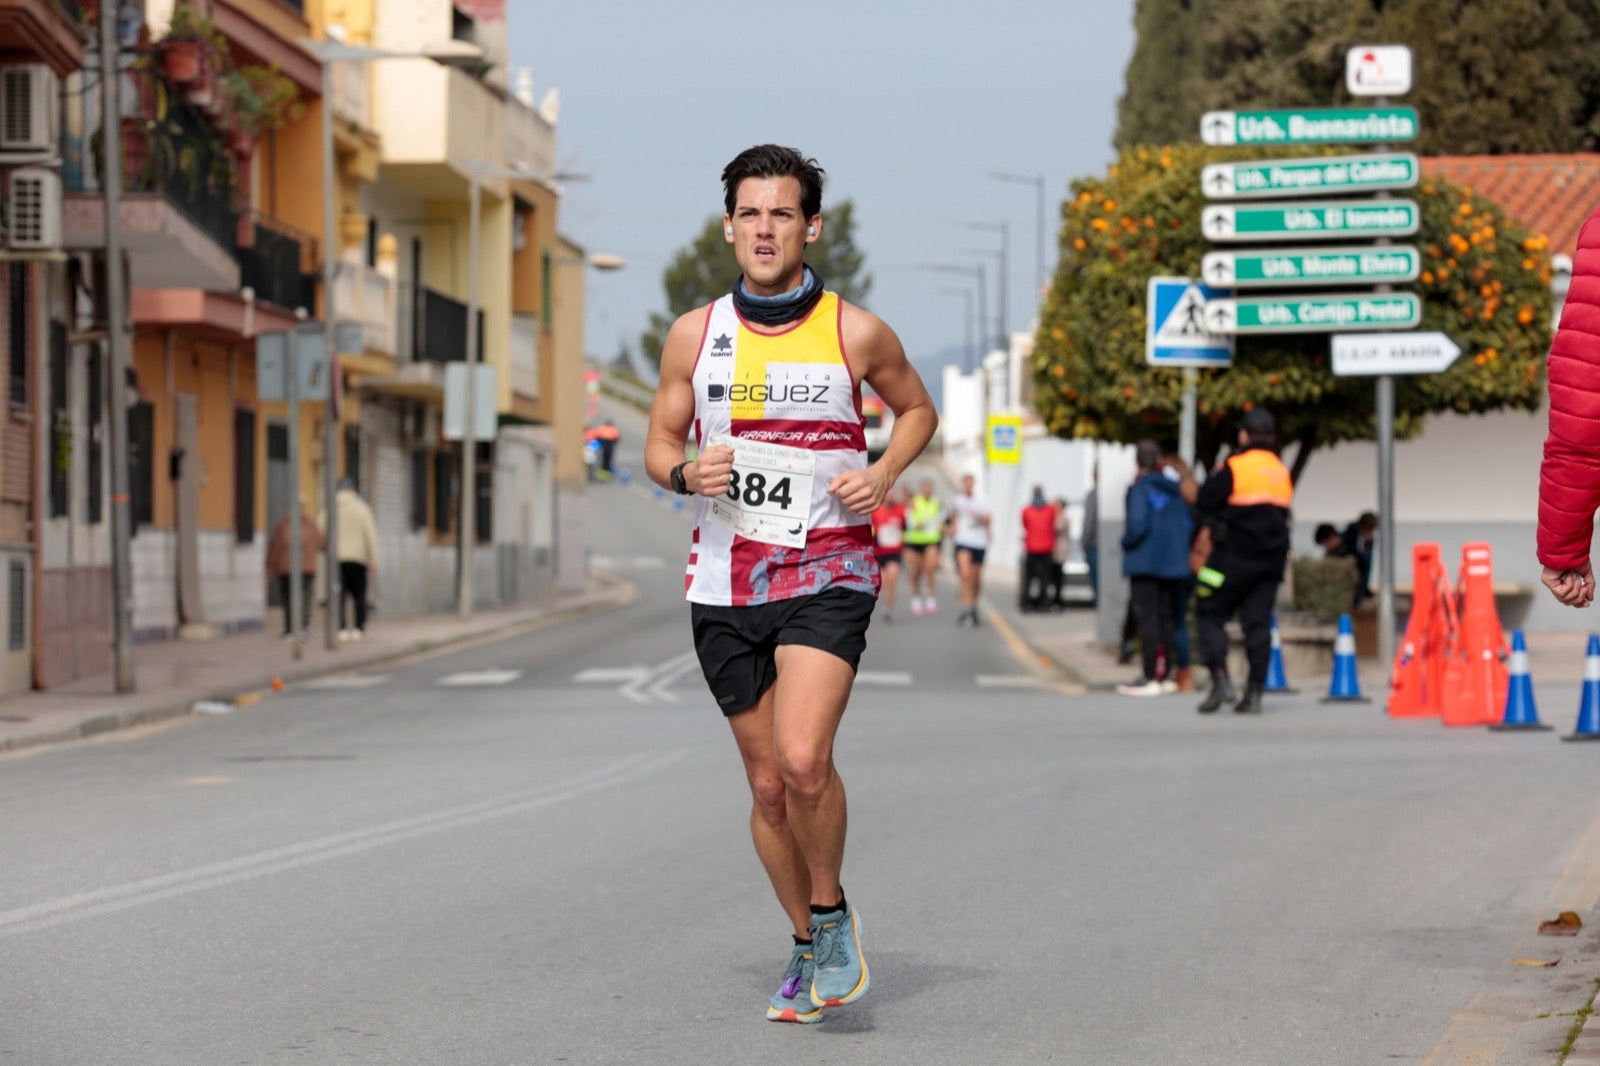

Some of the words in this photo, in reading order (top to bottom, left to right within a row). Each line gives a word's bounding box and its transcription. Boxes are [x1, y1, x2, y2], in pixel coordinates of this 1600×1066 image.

[1238, 116, 1287, 140] Urb.
[1288, 113, 1414, 139] Buenavista
[1284, 209, 1323, 230] Urb.
[1262, 257, 1298, 278] Urb.
[1258, 304, 1295, 324] Urb.
[739, 431, 803, 441] GRANADA
